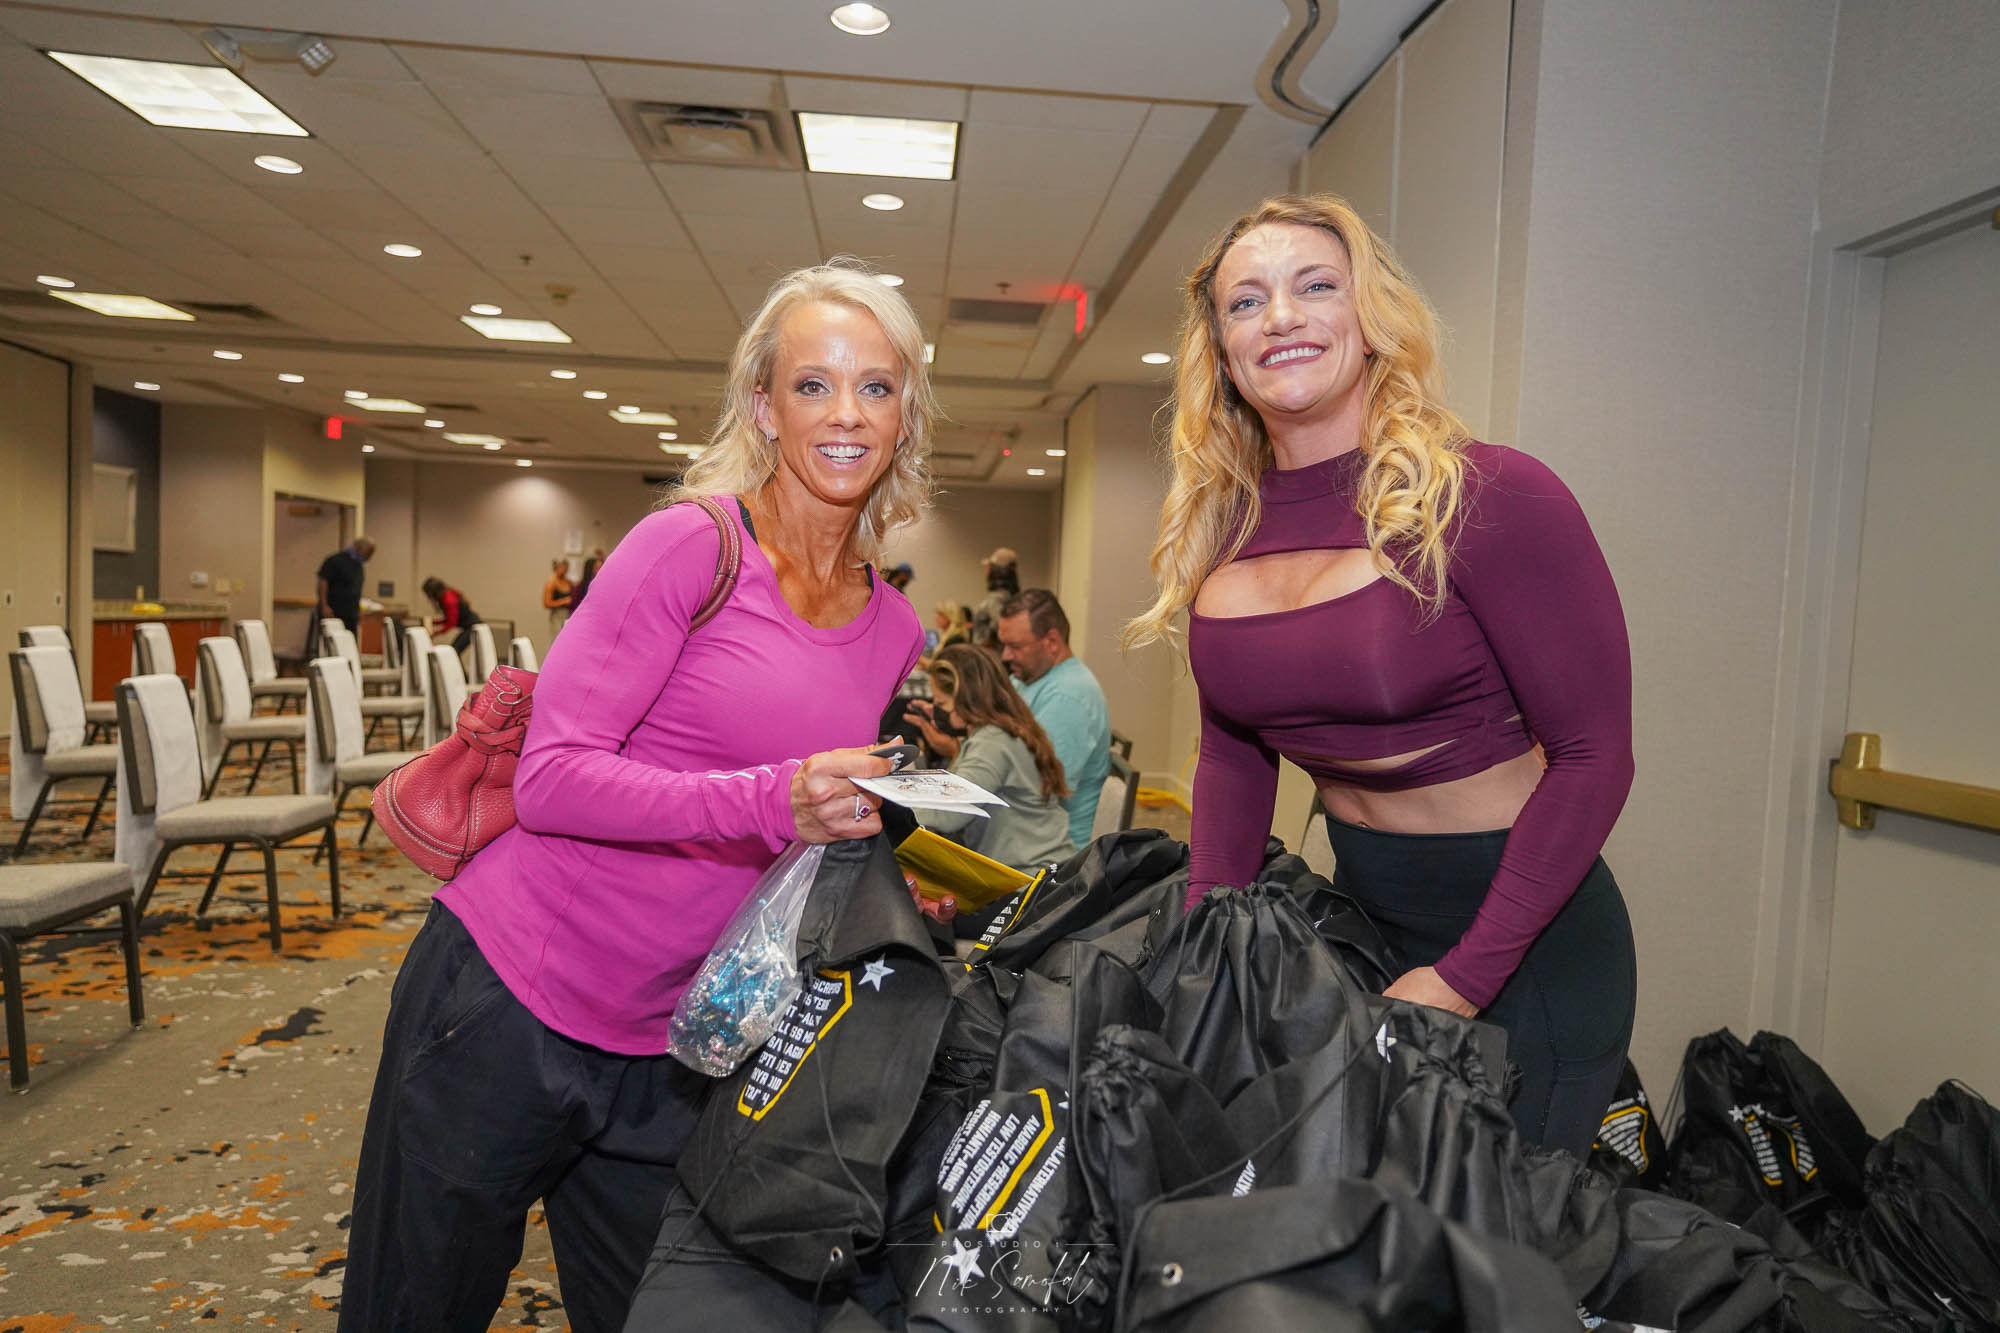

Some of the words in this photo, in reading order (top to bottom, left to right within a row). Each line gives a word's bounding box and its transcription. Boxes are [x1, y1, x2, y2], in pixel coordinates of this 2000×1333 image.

[942, 1109, 1002, 1193] HGH/ANTI-AGING
[999, 1112, 1021, 1143] LOW
[1003, 1114, 1041, 1166] ANABOLIC
[951, 1136, 1006, 1214] TESTOSTERONE
